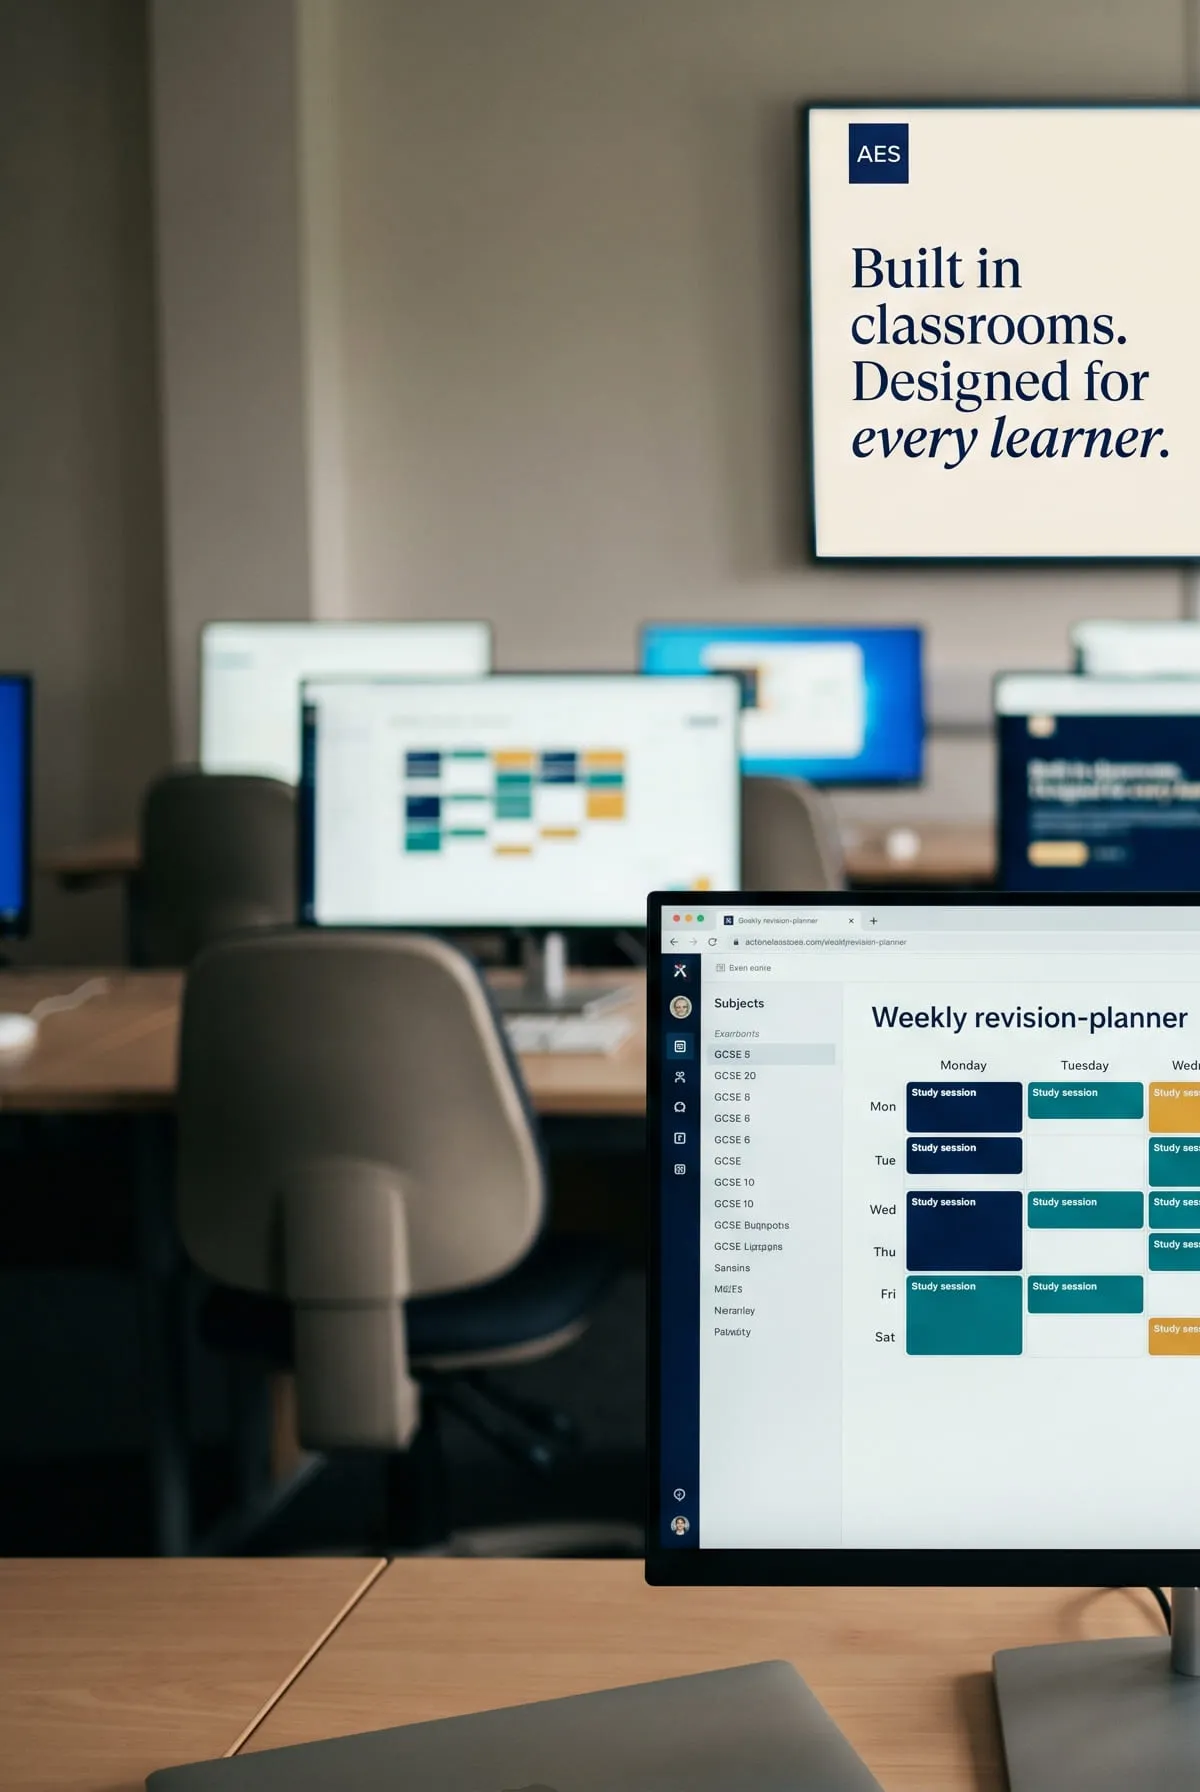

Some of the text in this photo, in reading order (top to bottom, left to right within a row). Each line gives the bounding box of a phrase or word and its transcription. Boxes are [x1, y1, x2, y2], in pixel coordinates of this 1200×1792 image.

[857, 145, 900, 162] AES
[852, 246, 1022, 288] Built in
[852, 303, 1126, 345] classrooms.
[852, 360, 1149, 412] Designed for
[852, 415, 1168, 469] every learner.
[715, 998, 764, 1010] Subjects
[872, 1006, 1188, 1034] Weekly revision-planner
[715, 1050, 741, 1058] GCSE
[941, 1060, 987, 1072] Monday
[1061, 1060, 1109, 1072] Tuesday
[715, 1072, 741, 1080] GCSE
[715, 1093, 741, 1101] GCSE
[912, 1088, 976, 1098] Study session
[1033, 1088, 1098, 1098] Study session
[1154, 1089, 1180, 1098] Study
[871, 1102, 896, 1111] Mon
[715, 1114, 741, 1122] GCSE
[715, 1136, 750, 1144] GCSE 6
[912, 1144, 938, 1153] Study
[1154, 1144, 1180, 1153] Study
[715, 1157, 741, 1165] GCSE
[875, 1156, 895, 1165] Tue
[715, 1178, 741, 1186] GCSE
[715, 1200, 753, 1208] GCSE 10
[912, 1198, 976, 1207] Study session
[1033, 1198, 1097, 1207] Study session
[1154, 1198, 1180, 1208] Study
[870, 1204, 896, 1214] Wed
[715, 1221, 741, 1229] GCSE
[714, 1242, 741, 1250] GCSE
[1154, 1240, 1180, 1250] Study
[874, 1247, 895, 1257] Thu
[715, 1264, 750, 1272] Sansins
[912, 1282, 976, 1292] Study session
[1033, 1282, 1097, 1292] Study session
[882, 1289, 895, 1299] Fri
[1154, 1325, 1180, 1334] Study
[876, 1332, 895, 1342] Sat
